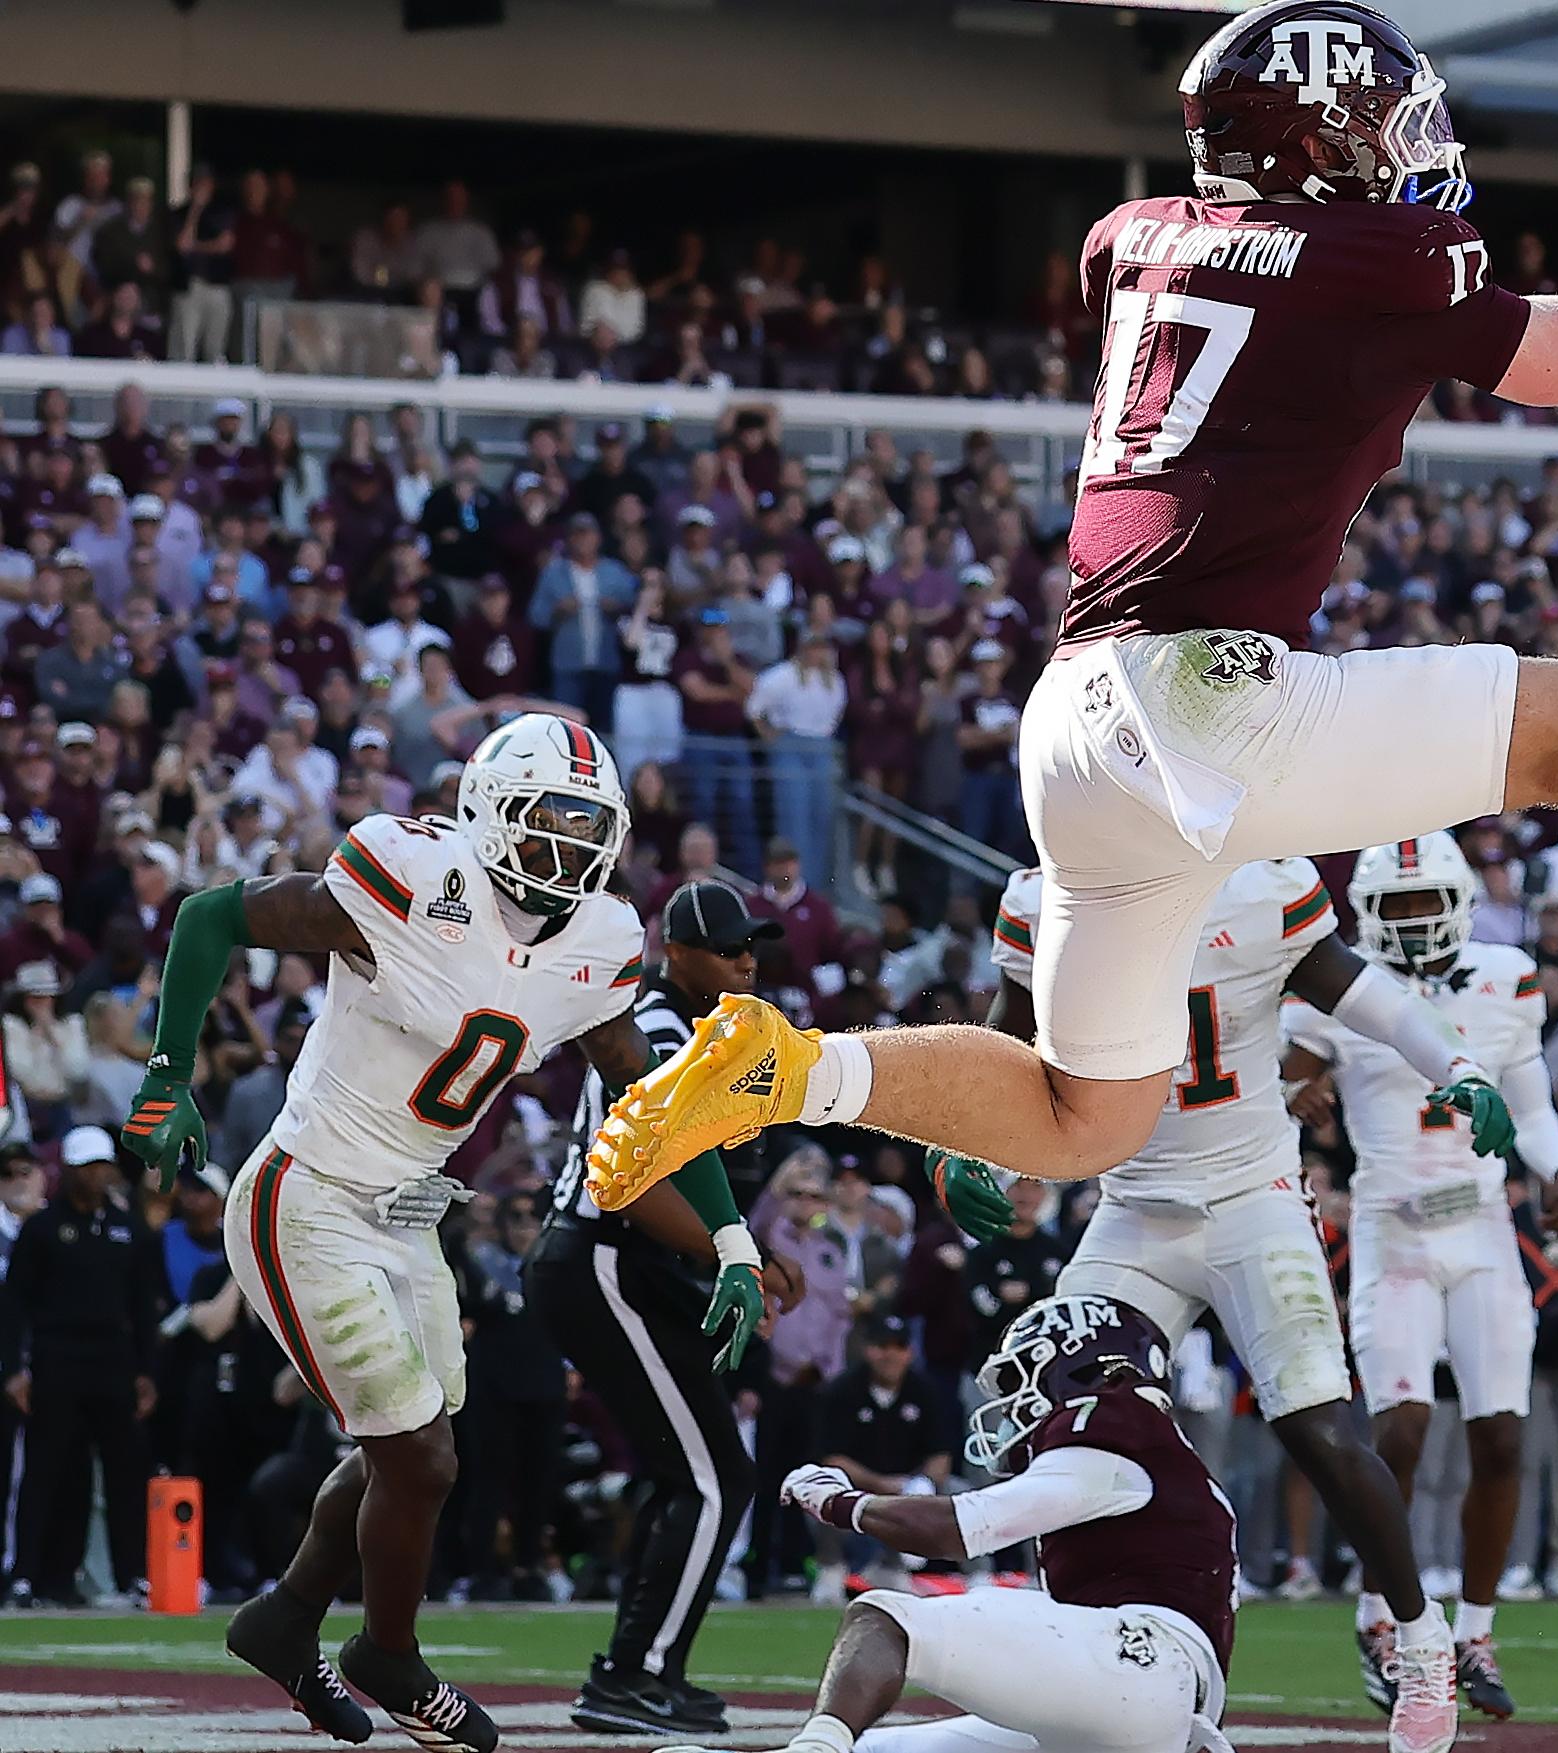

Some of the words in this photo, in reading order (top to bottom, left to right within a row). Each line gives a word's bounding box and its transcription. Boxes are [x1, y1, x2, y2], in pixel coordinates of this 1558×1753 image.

[1446, 240, 1488, 306] 17
[1086, 288, 1256, 474] 17
[407, 1008, 530, 1131] 0
[729, 1047, 775, 1094] adidas
[1065, 1396, 1099, 1432] 7
